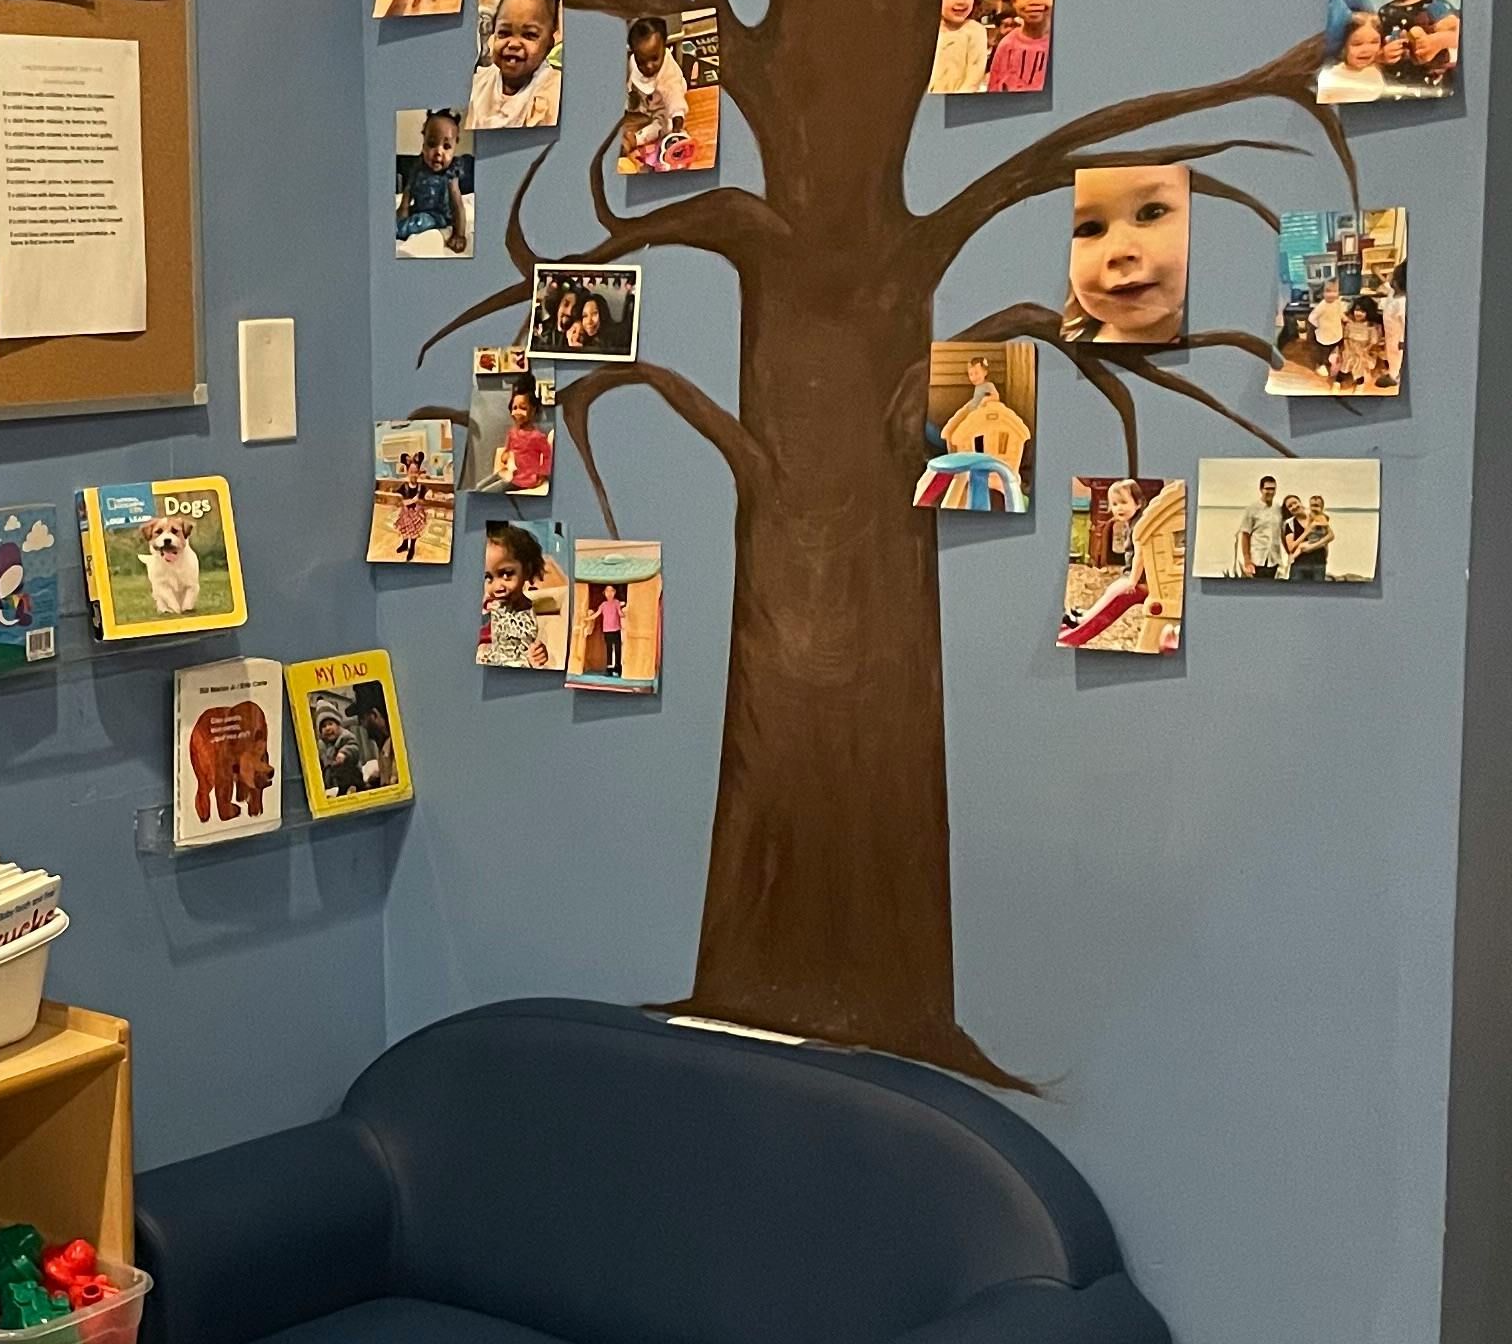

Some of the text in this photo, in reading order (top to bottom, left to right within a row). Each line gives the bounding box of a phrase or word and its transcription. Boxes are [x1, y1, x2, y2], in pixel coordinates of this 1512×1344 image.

[164, 496, 212, 519] Dogs
[314, 661, 368, 685] MY DAD
